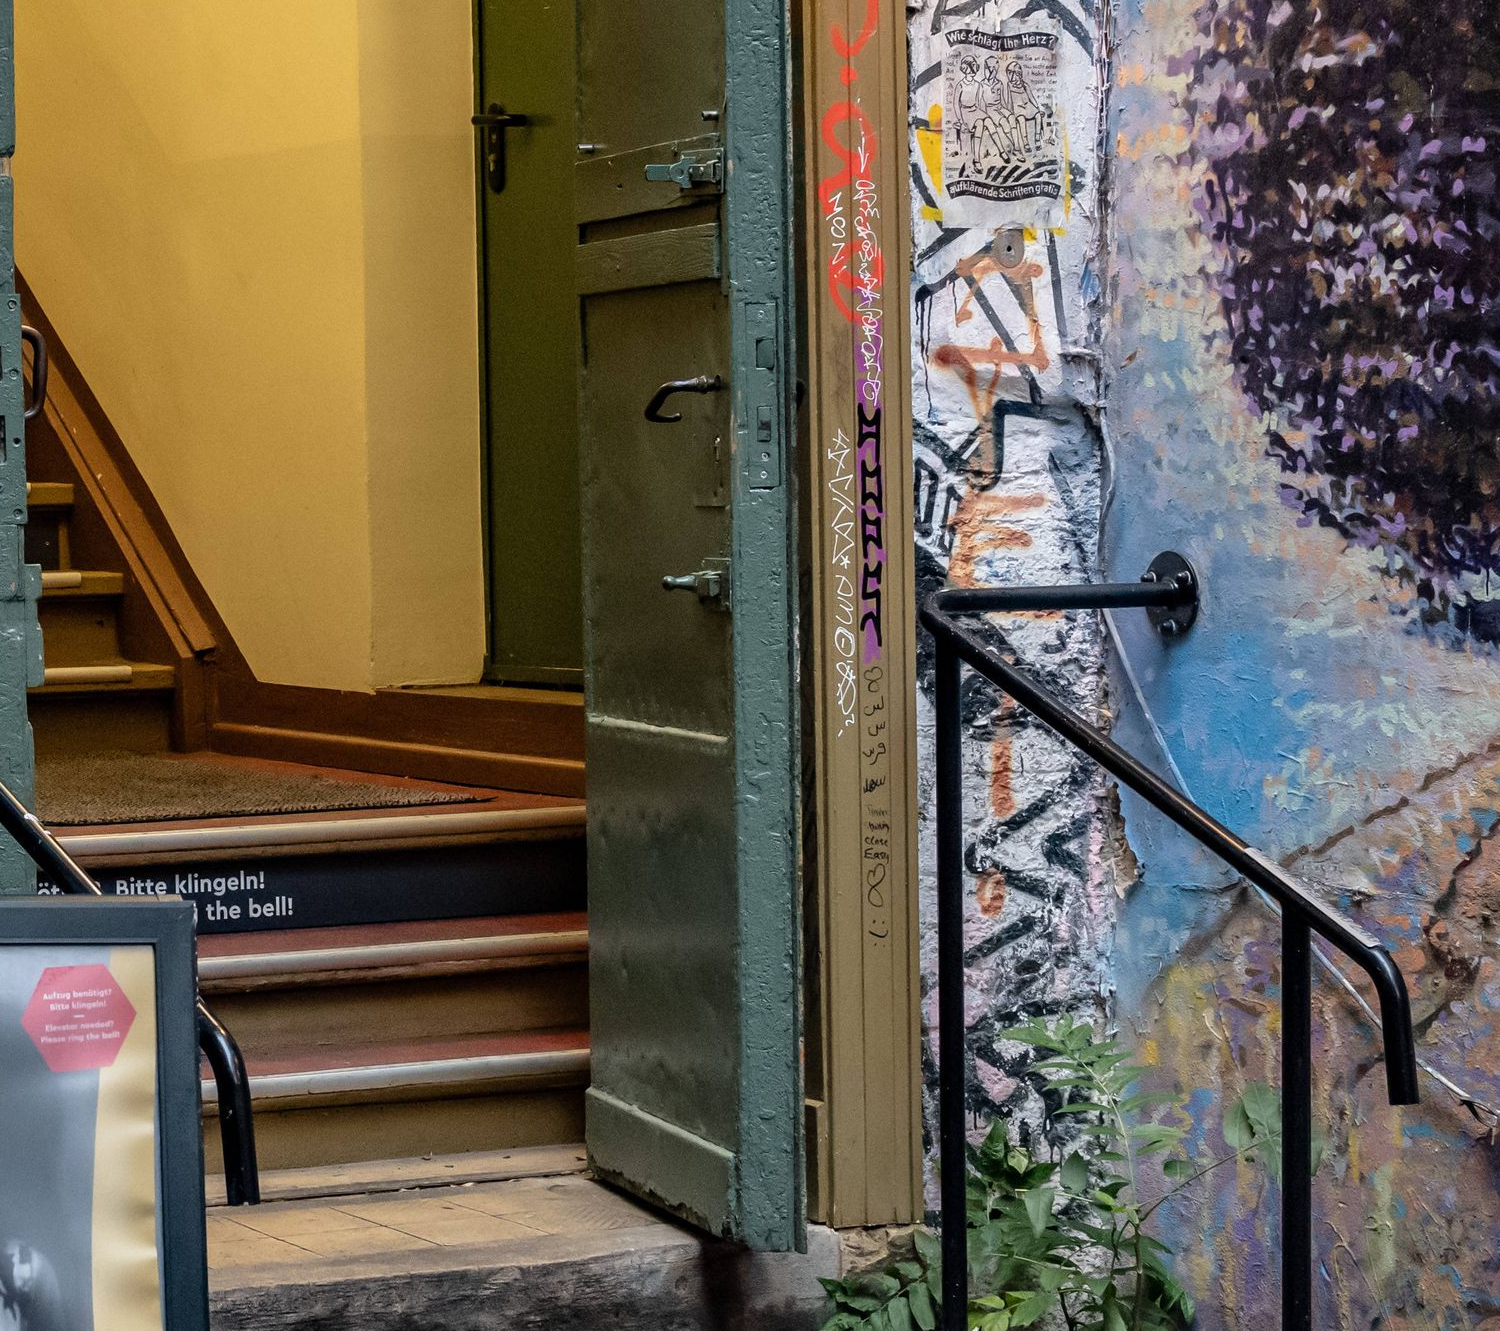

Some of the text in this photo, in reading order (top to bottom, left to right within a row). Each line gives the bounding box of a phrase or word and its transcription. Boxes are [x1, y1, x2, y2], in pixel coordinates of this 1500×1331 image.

[946, 31, 966, 45] Wie
[1003, 37, 1019, 49] Ihr
[949, 180, 999, 199] aufklärende
[999, 186, 1034, 199] Schriften
[116, 870, 265, 898] Bitte klingeln!
[206, 896, 294, 921] the bell!
